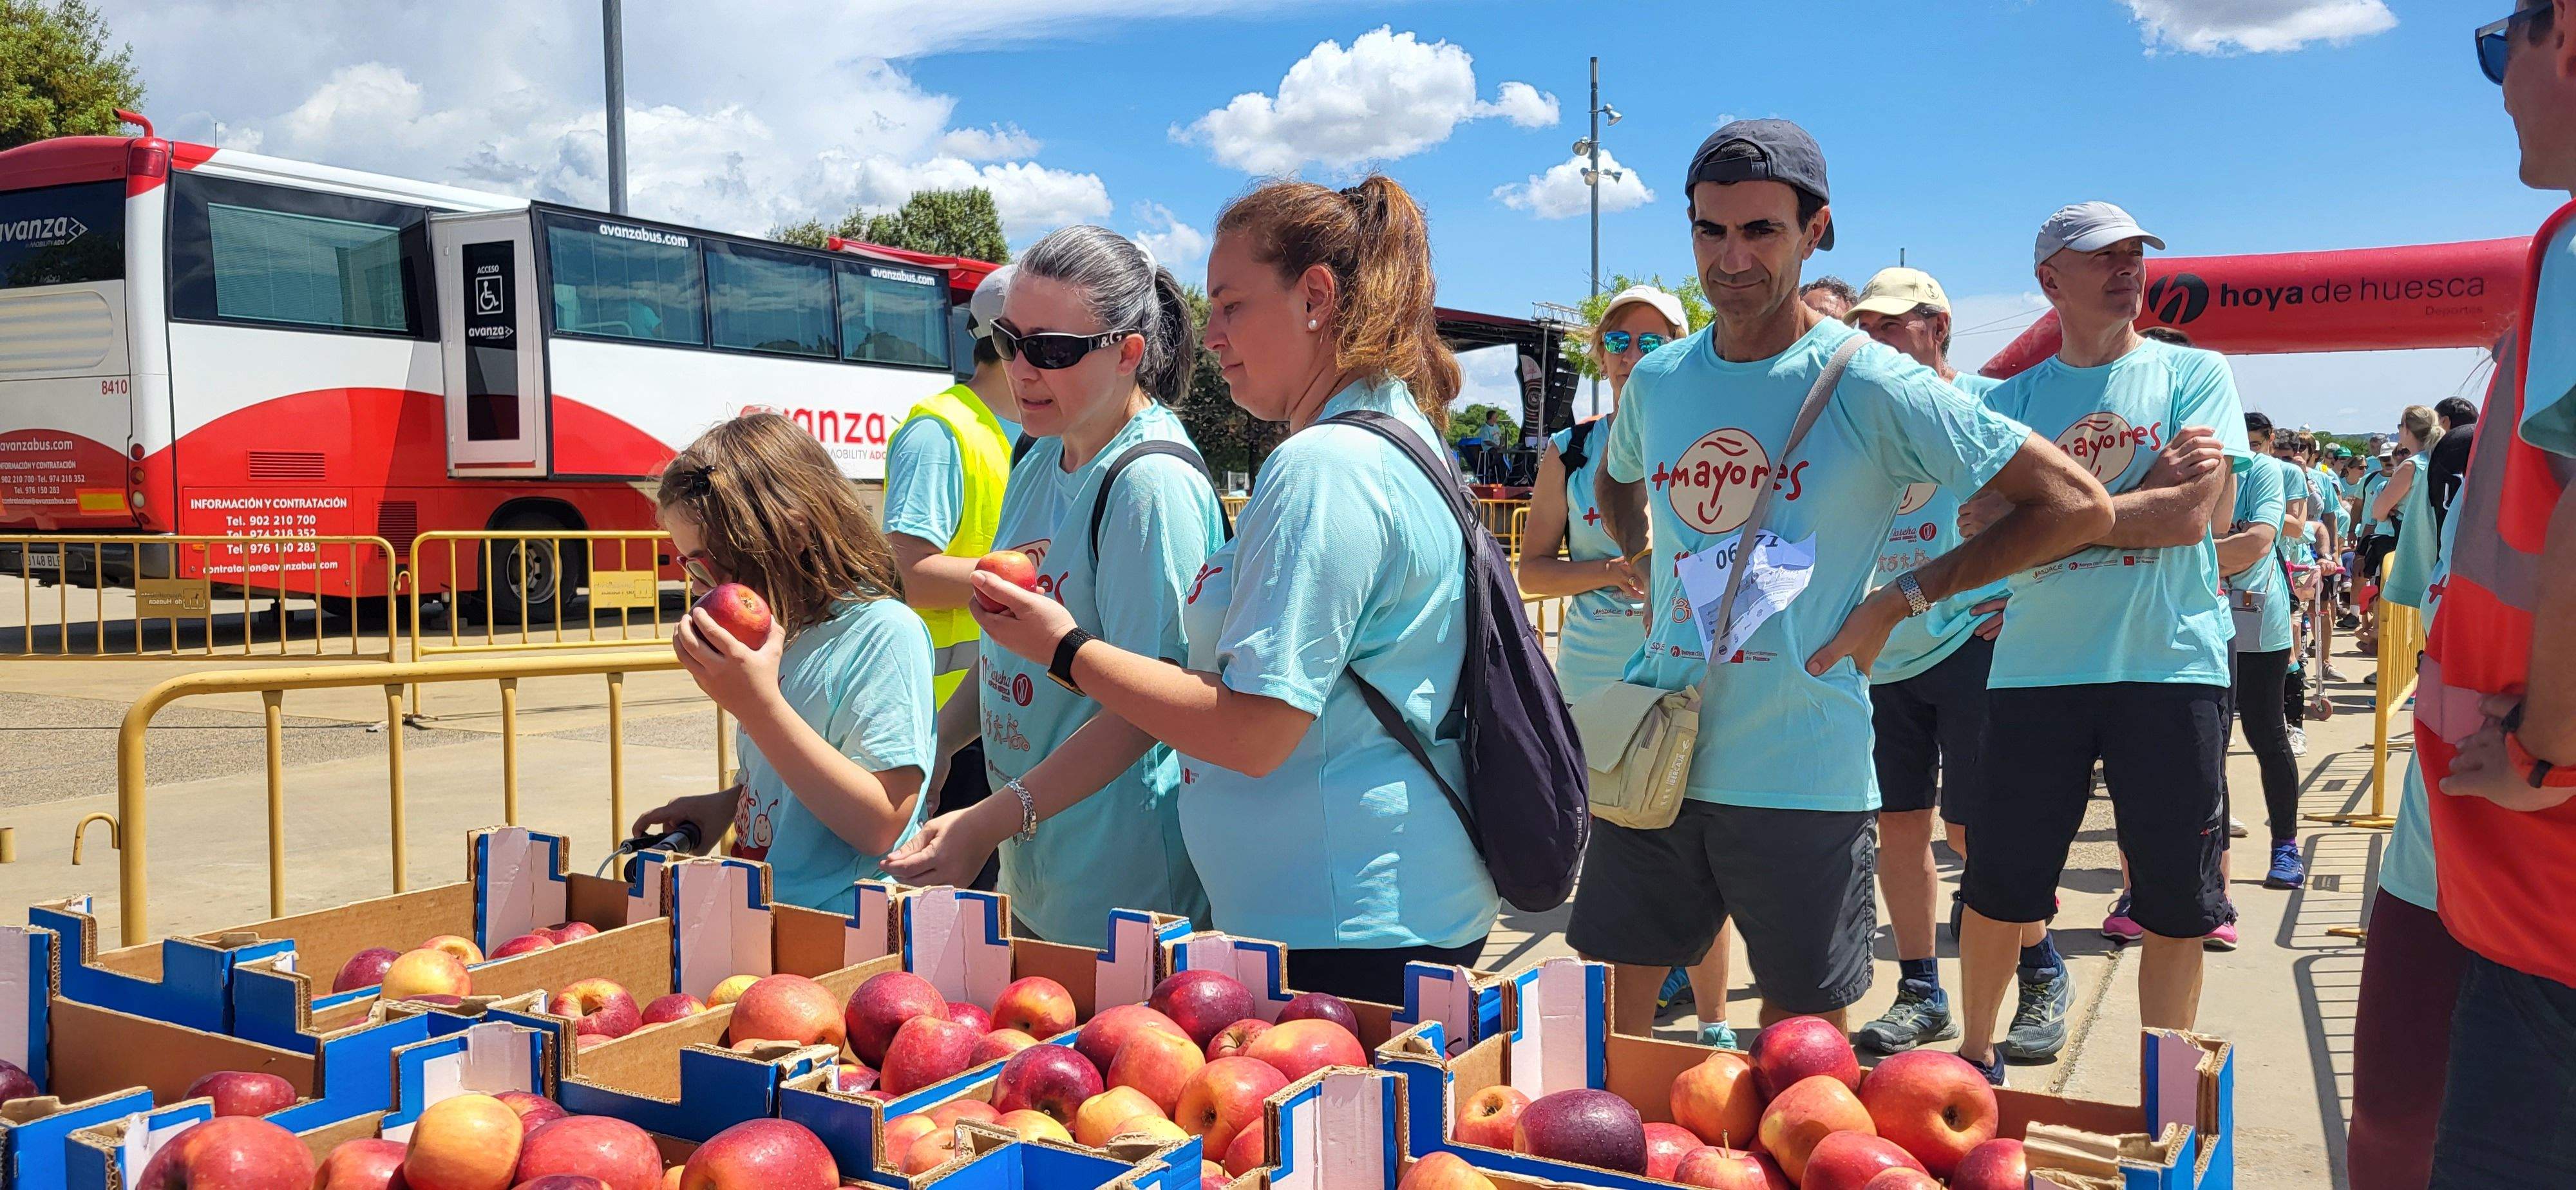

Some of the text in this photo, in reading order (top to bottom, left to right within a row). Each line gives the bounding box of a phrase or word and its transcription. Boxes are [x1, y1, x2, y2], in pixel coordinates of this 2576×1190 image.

[599, 223, 689, 248] avanzabus.com
[477, 265, 499, 274] ACCESO
[871, 267, 935, 286] avanzabus.com
[2220, 276, 2484, 311] hoya de huesca
[2425, 306, 2483, 316] Deportes
[468, 326, 504, 337] avanza
[101, 379, 128, 395] 8410
[740, 405, 887, 446] anza
[0, 437, 73, 451] avanzabus.com
[36, 460, 76, 469] CONTRATACIÓN
[61, 475, 72, 483] 218
[191, 496, 347, 509] INFORMACIÓN Y CONTRATACIÓN
[226, 515, 316, 526] Tel. 902 210 700
[250, 543, 270, 554] 976
[297, 542, 316, 552] 283
